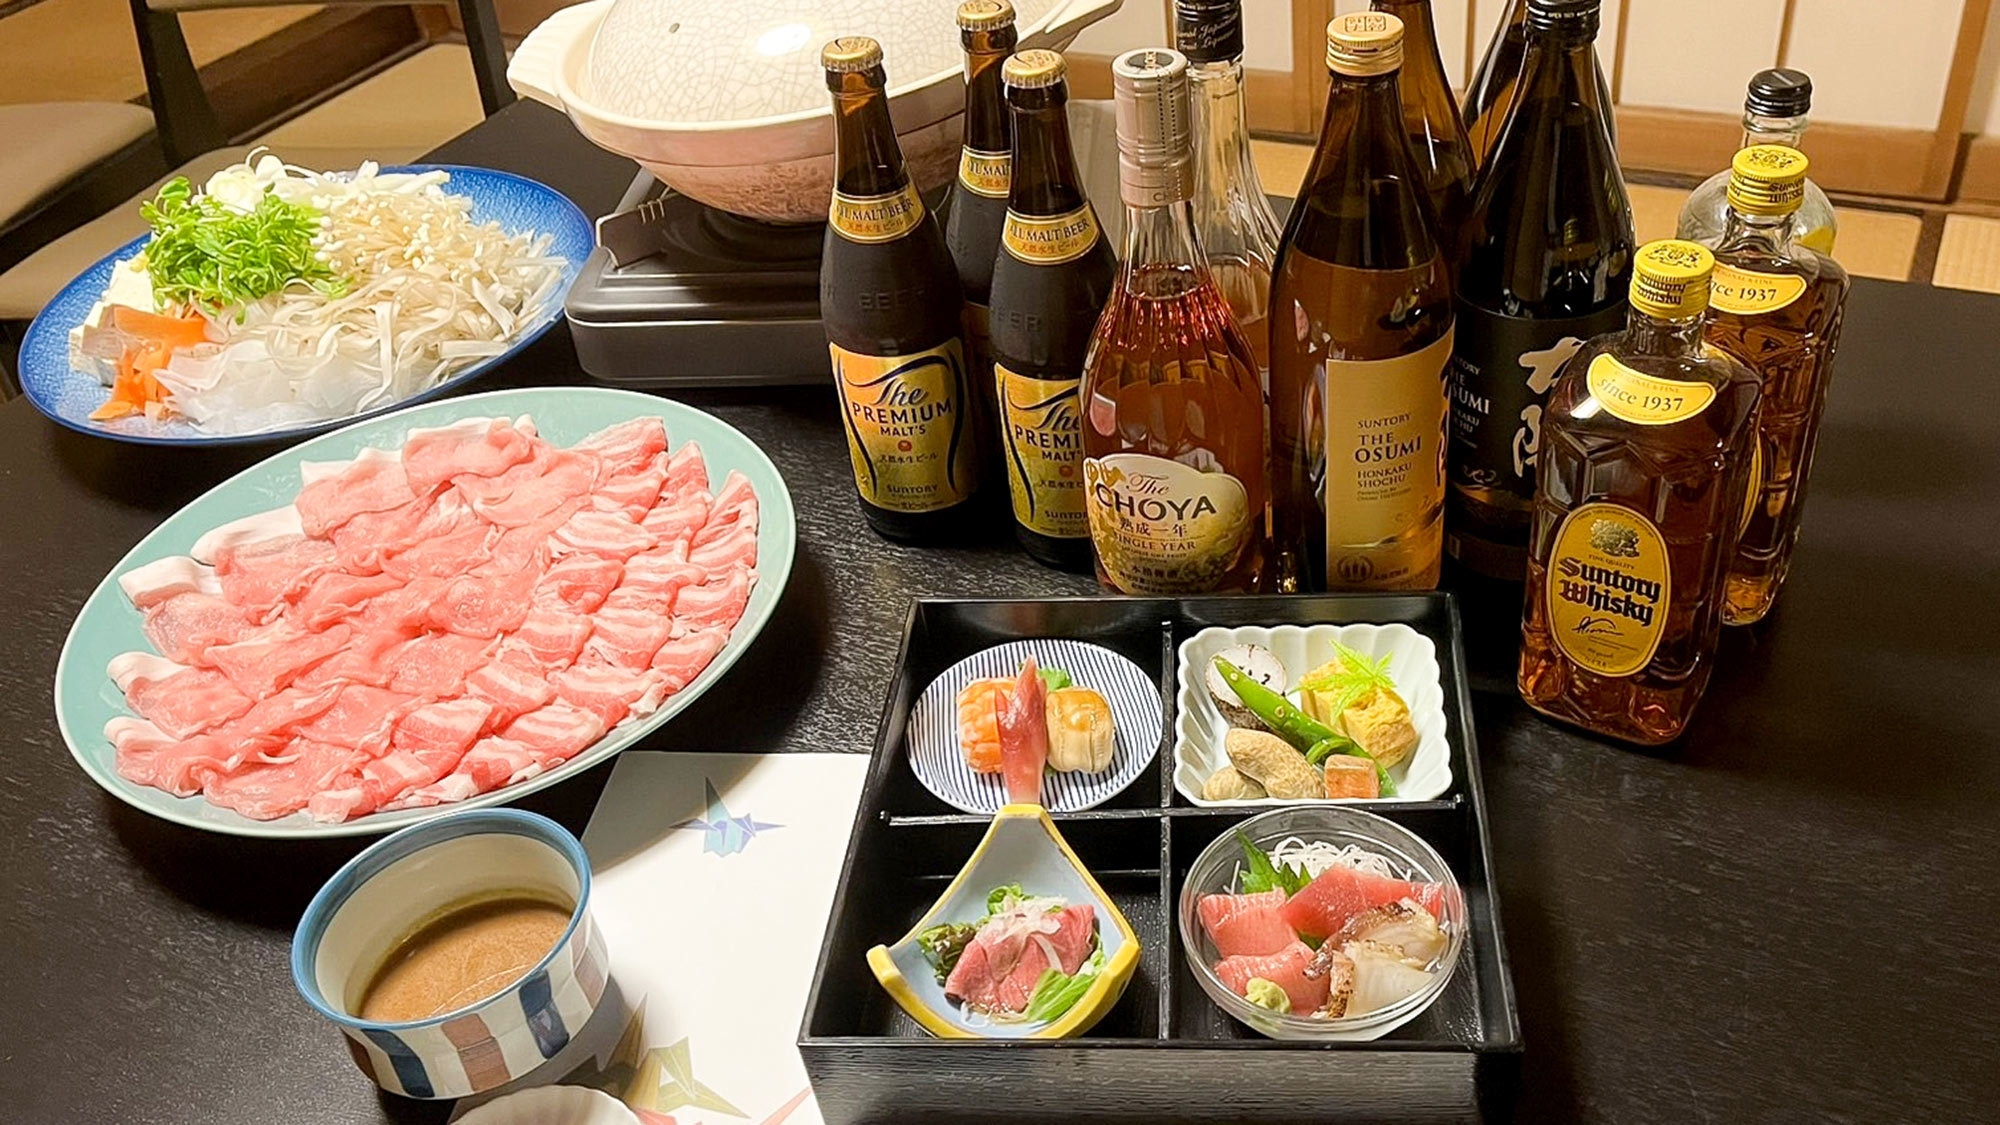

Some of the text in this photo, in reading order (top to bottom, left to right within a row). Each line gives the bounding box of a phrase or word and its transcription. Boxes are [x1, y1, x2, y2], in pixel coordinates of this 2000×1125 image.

[852, 208, 886, 221] MALT
[888, 198, 914, 218] BEER
[1027, 229, 1063, 243] MALT
[1063, 218, 1090, 238] BEER
[1739, 287, 1777, 301] 1937
[869, 377, 928, 406] The
[1453, 382, 1491, 415] SUMI
[1597, 378, 1638, 405] since
[1641, 395, 1684, 412] 1937
[853, 397, 953, 425] PREMIUM
[1358, 412, 1412, 429] SUNTORY
[879, 425, 926, 437] MALT'S
[1014, 423, 1080, 449] PREMI
[1358, 431, 1394, 446] THE
[1042, 450, 1081, 462] MALT'
[1355, 435, 1422, 463] OSUMI
[1358, 462, 1413, 479] HONKAKU
[1358, 473, 1406, 488] SHOCHU
[887, 484, 938, 494] SUNTORY
[1126, 472, 1170, 496] The
[1095, 482, 1217, 522] CHOYA
[1045, 510, 1084, 519] SUNTO
[1119, 517, 1188, 538] 熟成一年
[1114, 531, 1197, 551] SINGLE YEAR
[1605, 558, 1635, 570] QUALITY
[1558, 556, 1662, 604] Suntory
[1559, 579, 1654, 627] Whisky
